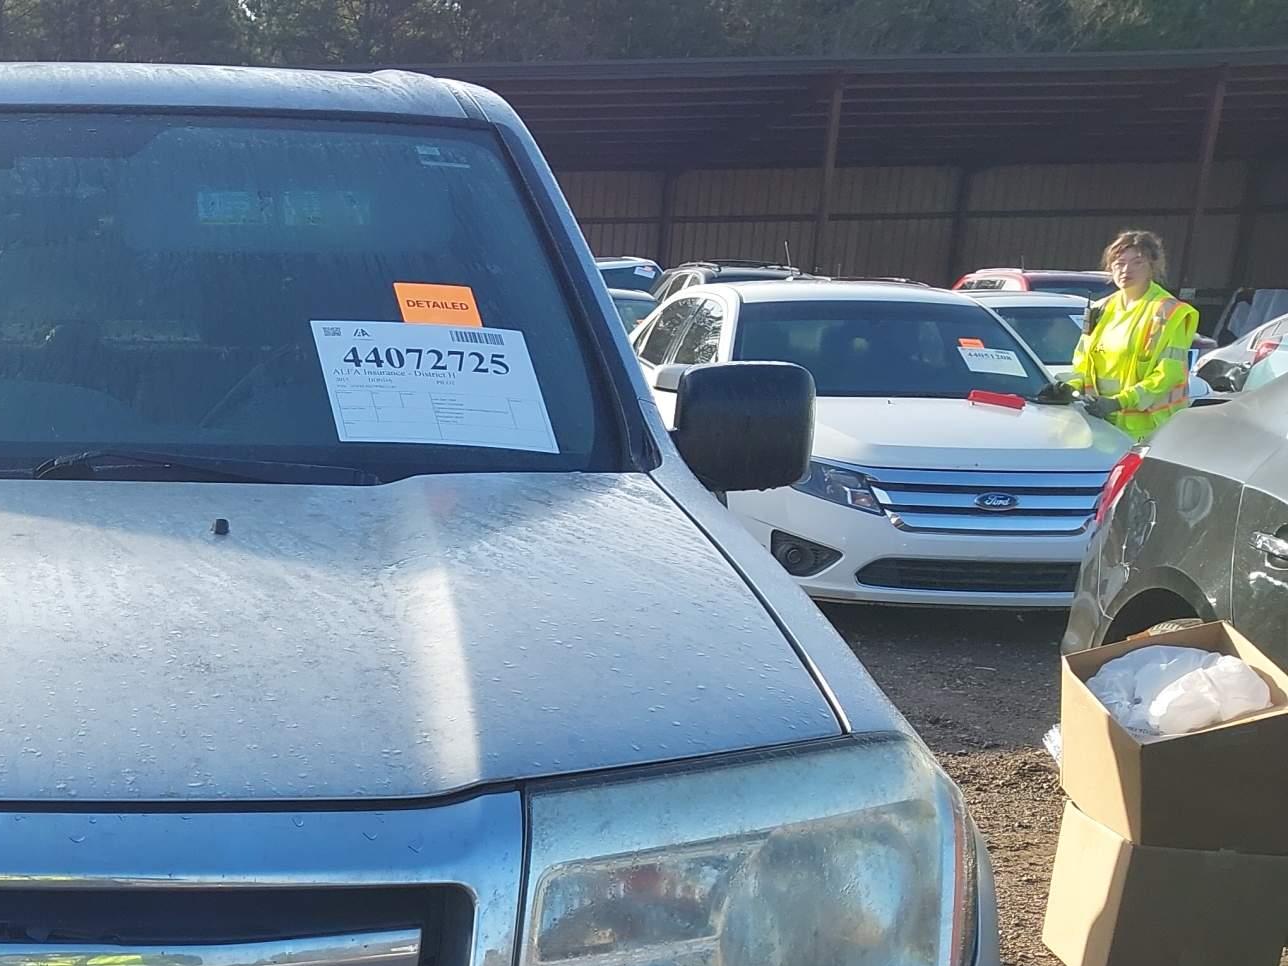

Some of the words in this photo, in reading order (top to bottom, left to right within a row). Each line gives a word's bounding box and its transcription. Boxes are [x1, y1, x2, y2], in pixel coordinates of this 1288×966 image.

[406, 299, 469, 312] DETAILED
[343, 346, 510, 375] 44072725
[363, 368, 406, 377] Insurance
[414, 369, 447, 378] District
[985, 495, 1010, 505] Ford
